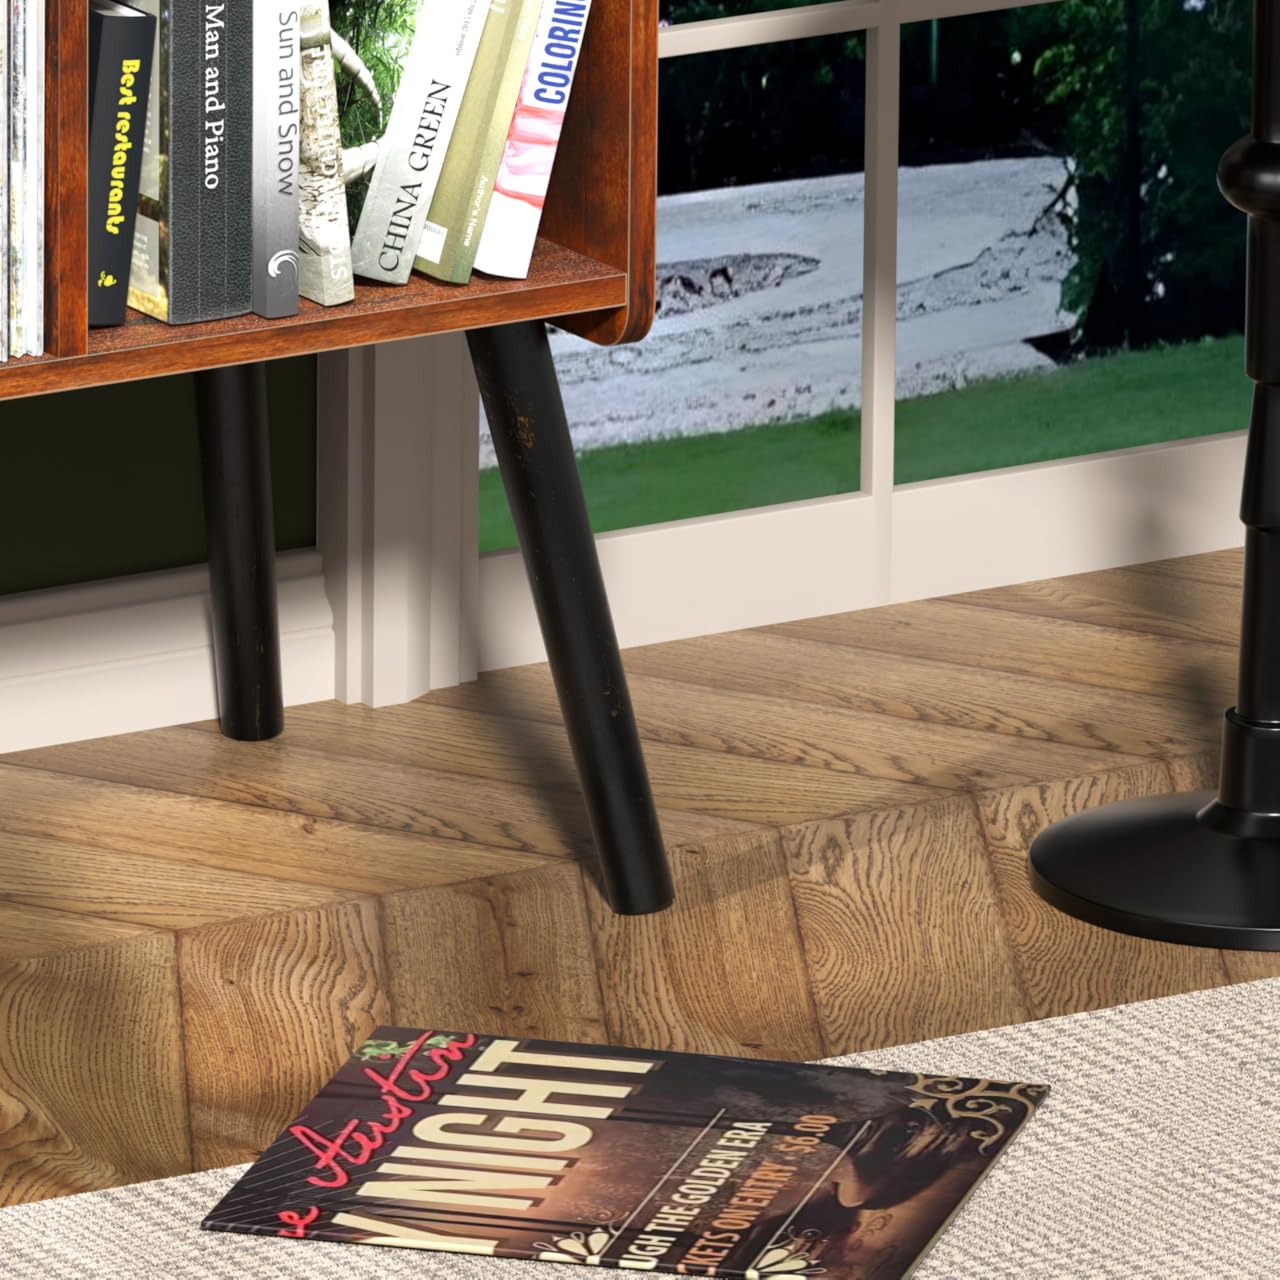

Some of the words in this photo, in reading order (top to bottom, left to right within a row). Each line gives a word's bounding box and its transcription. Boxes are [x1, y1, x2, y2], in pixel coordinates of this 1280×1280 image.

[204, 4, 225, 61] Man
[278, 11, 298, 60] Sun
[118, 58, 141, 106] Best
[204, 68, 226, 113] and
[278, 68, 298, 116] and
[105, 111, 133, 235] restaurants
[204, 119, 225, 190] Piano
[278, 122, 298, 196] Snow
[378, 180, 423, 272] CHINA
[408, 78, 452, 172] GREEN
[289, 1030, 477, 1188] Austin
[356, 1039, 657, 1211] NIGHT
[717, 1121, 774, 1148] ERA
[773, 1114, 838, 1154] $6.00
[671, 1149, 750, 1205] GOLDEN
[729, 1159, 798, 1207] ENTRY
[643, 1205, 702, 1232] THE
[711, 1208, 761, 1231] ON
